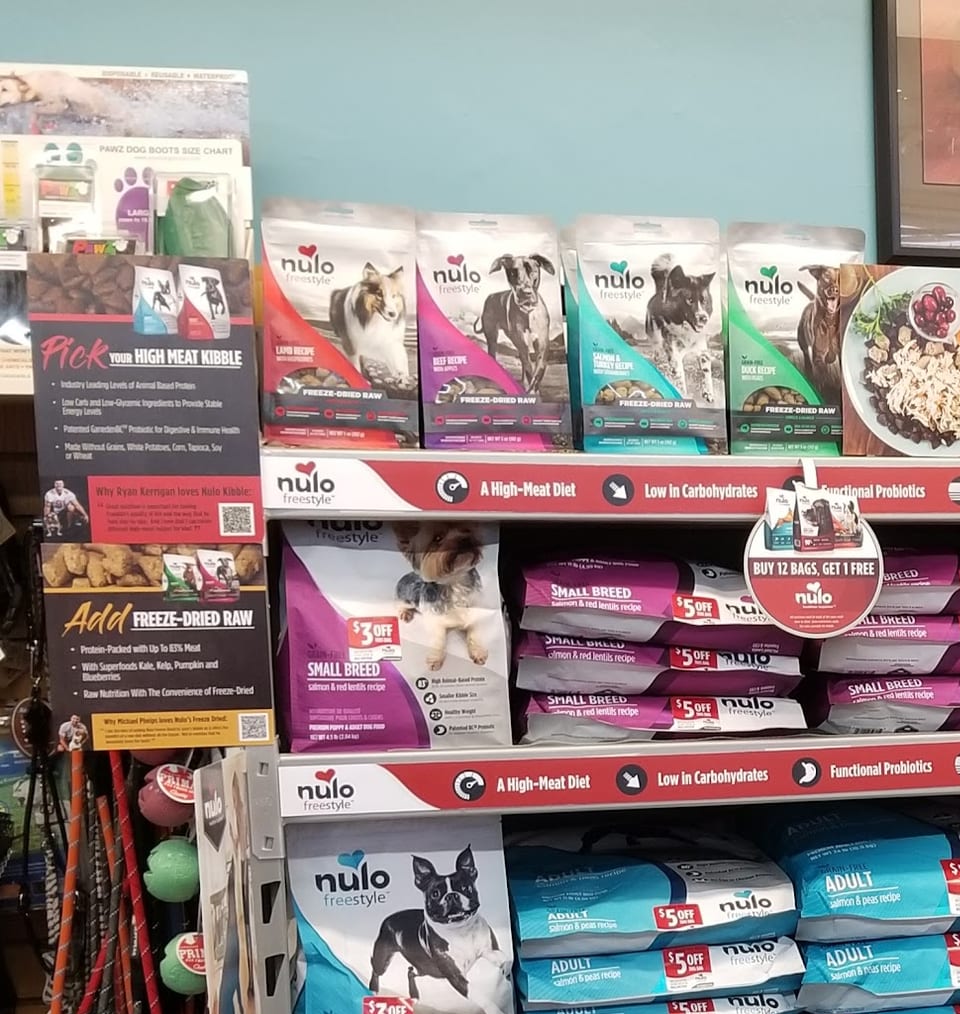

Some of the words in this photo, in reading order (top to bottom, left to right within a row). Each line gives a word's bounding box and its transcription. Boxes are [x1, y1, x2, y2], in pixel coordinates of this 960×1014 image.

[100, 145, 124, 153] PAWZ
[126, 146, 146, 154] DOG
[149, 147, 179, 155] BOOTS
[182, 147, 200, 155] SIZE
[204, 148, 232, 156] CHART
[281, 256, 334, 275] nulo
[286, 275, 334, 286] freestyle
[745, 275, 792, 294] nulo
[41, 335, 109, 371] Pick
[110, 352, 132, 363] YOUR
[135, 349, 162, 364] HIGH
[168, 349, 198, 364] MEAT
[202, 350, 242, 365] KIBBLE
[766, 406, 816, 414] FREEZE-DRIED
[278, 472, 335, 493] nulo
[481, 482, 488, 495] A
[491, 482, 550, 498] High-Meat
[553, 483, 575, 497] Diet
[645, 483, 667, 498] Low
[669, 483, 680, 498] in
[682, 483, 757, 500] Carbohydrates
[283, 494, 332, 506] freestyle
[754, 562, 775, 576] BUY
[778, 562, 787, 575] 12
[791, 562, 820, 577] BAGS,
[822, 562, 841, 576] GET
[843, 562, 848, 575] 1
[852, 563, 875, 576] FREE
[62, 601, 133, 637] Add
[133, 611, 220, 627] FREEZE-DRIED
[224, 611, 252, 626] RAW
[354, 622, 373, 645] $3
[373, 624, 392, 637] OFF
[81, 645, 131, 655] Protein-Packed
[133, 644, 148, 653] with
[150, 645, 158, 655] Up
[160, 645, 168, 653] To
[185, 644, 200, 652] Meat
[308, 662, 341, 677] SMALL
[345, 662, 380, 677] BREED
[308, 682, 329, 691] salmon
[331, 682, 336, 690] &
[337, 682, 348, 690] red
[349, 682, 366, 690] lentils
[368, 683, 386, 692] recipe
[315, 862, 390, 892] nulo
[324, 892, 387, 907] freestyle
